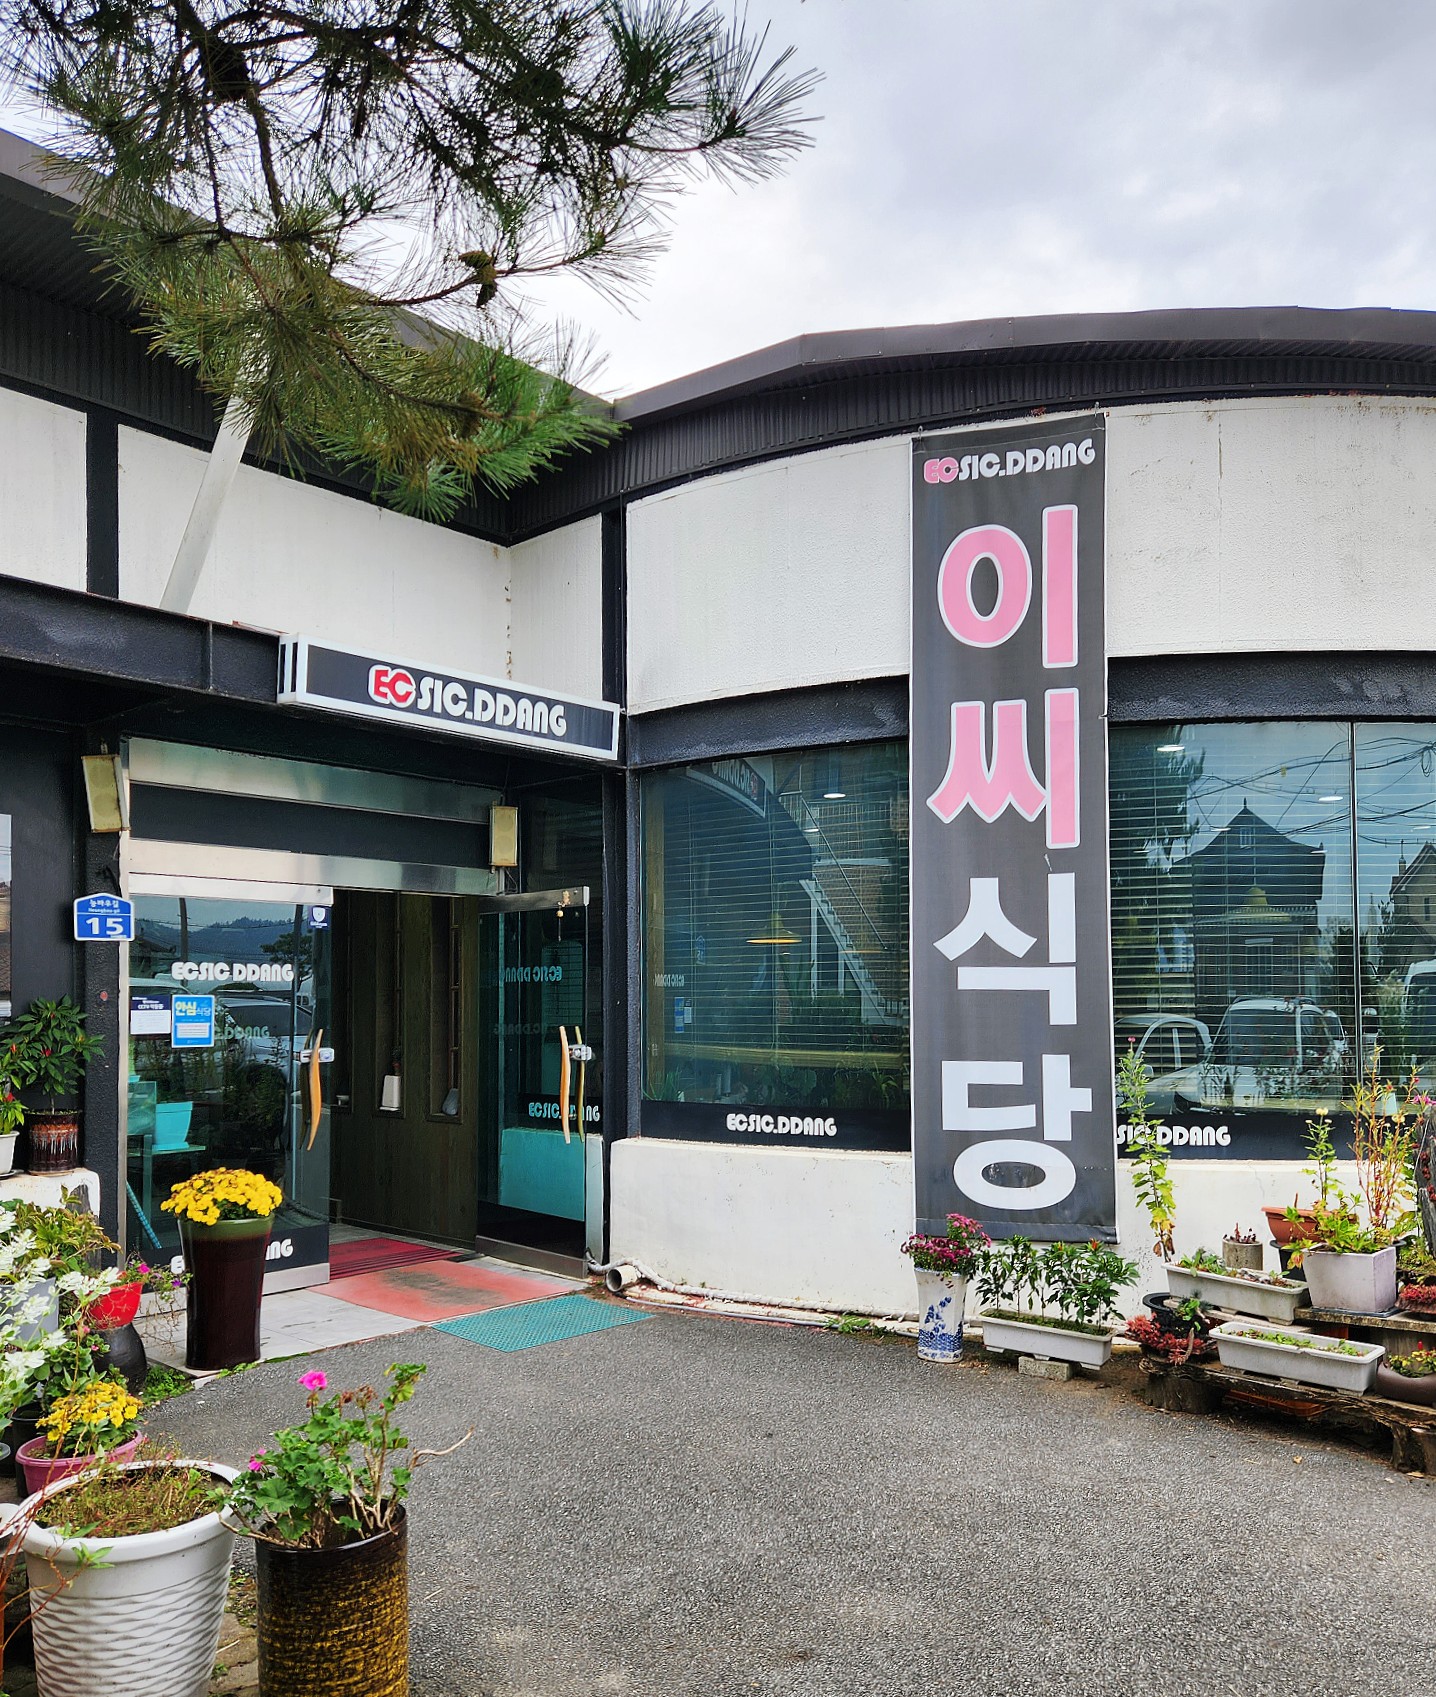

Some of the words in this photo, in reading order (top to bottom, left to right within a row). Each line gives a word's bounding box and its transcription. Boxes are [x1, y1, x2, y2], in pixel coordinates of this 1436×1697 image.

[85, 917, 124, 935] 15
[232, 963, 295, 981] DDANG
[726, 1113, 838, 1136] ECSIC.DDANG
